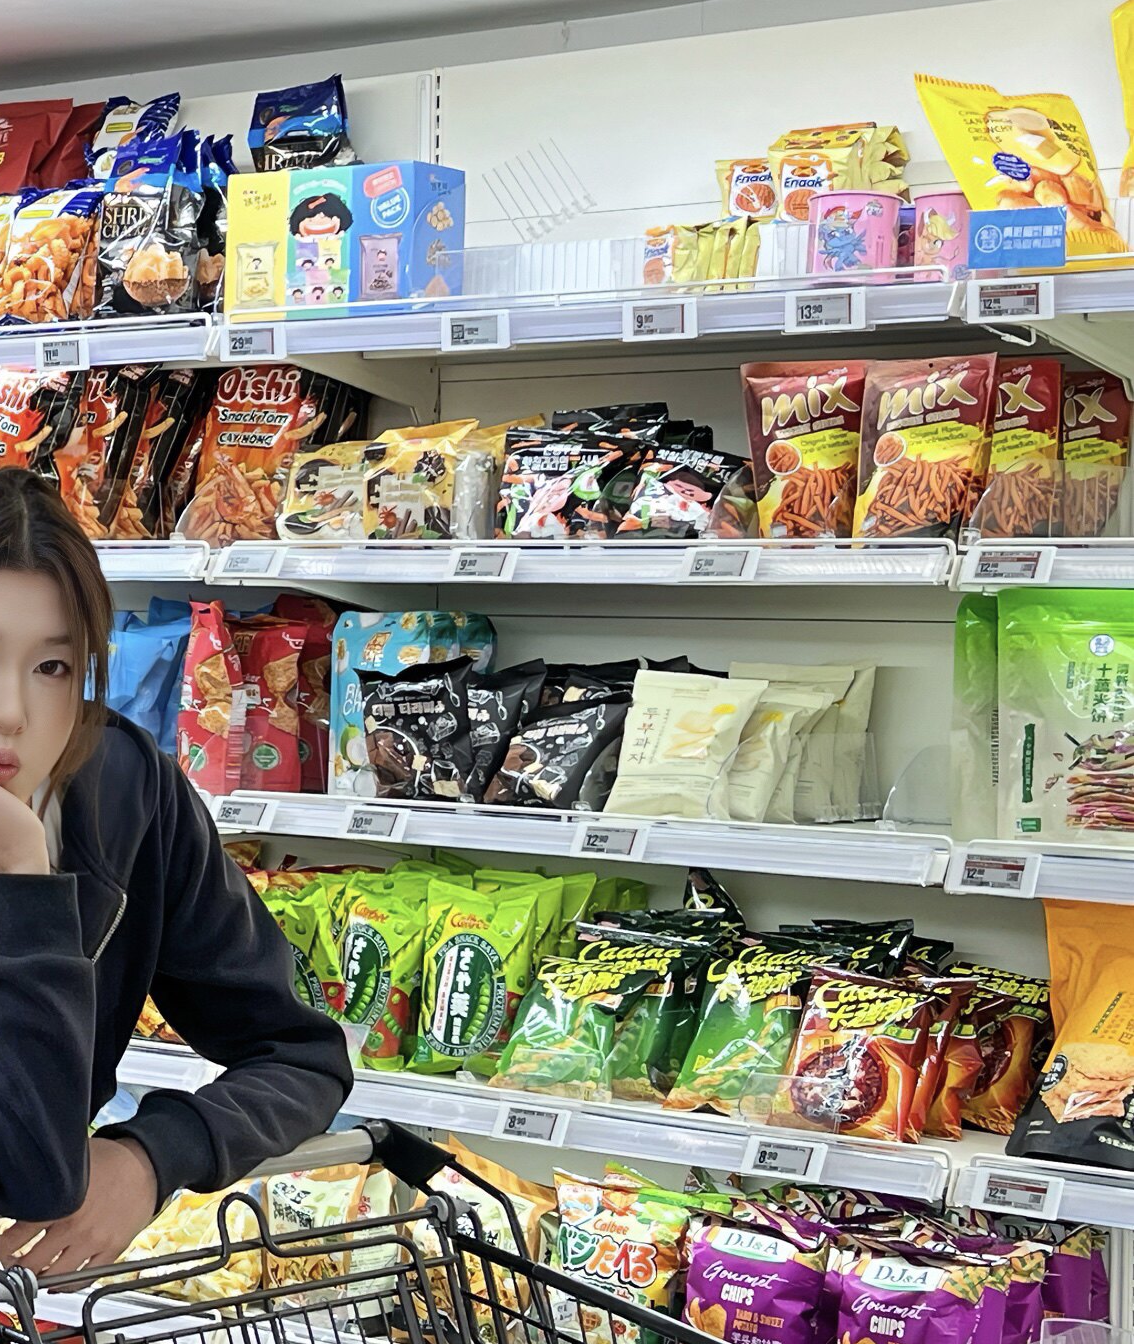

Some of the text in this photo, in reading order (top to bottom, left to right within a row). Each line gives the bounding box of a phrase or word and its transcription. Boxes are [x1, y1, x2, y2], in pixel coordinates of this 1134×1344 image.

[736, 174, 773, 185] Enaak
[784, 177, 824, 188] Enaak
[217, 366, 301, 405] Oishi
[760, 375, 861, 437] mix
[876, 369, 979, 431] mix
[219, 409, 258, 423] Snack
[480, 940, 501, 964] SAYA
[579, 940, 683, 963] Cadina
[978, 976, 1050, 1004] 迪那
[593, 1218, 630, 1236] Calbee
[558, 1225, 657, 1284] ベジたべる
[724, 1232, 780, 1255] DJ&A
[703, 1260, 789, 1290] Gourmet
[874, 1264, 929, 1286] DJ&A
[721, 1283, 754, 1306] CHIPS
[851, 1294, 937, 1321] Gourmet
[870, 1315, 906, 1339] CHIPS
